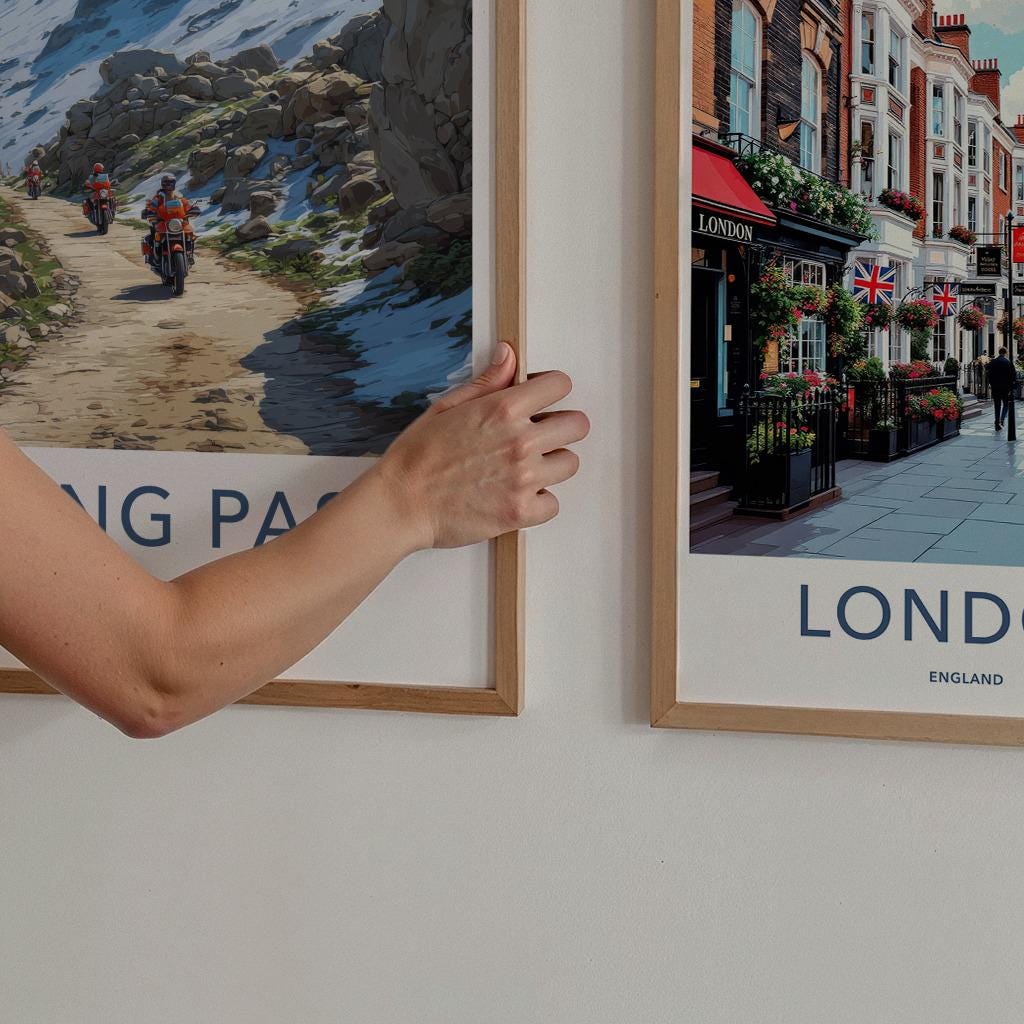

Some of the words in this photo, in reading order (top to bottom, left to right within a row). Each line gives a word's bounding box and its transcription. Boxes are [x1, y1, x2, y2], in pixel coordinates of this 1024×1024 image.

[698, 213, 754, 243] LONDON
[211, 488, 339, 549] PA
[800, 584, 1024, 645] LOND
[928, 670, 1005, 687] ENGLAND
